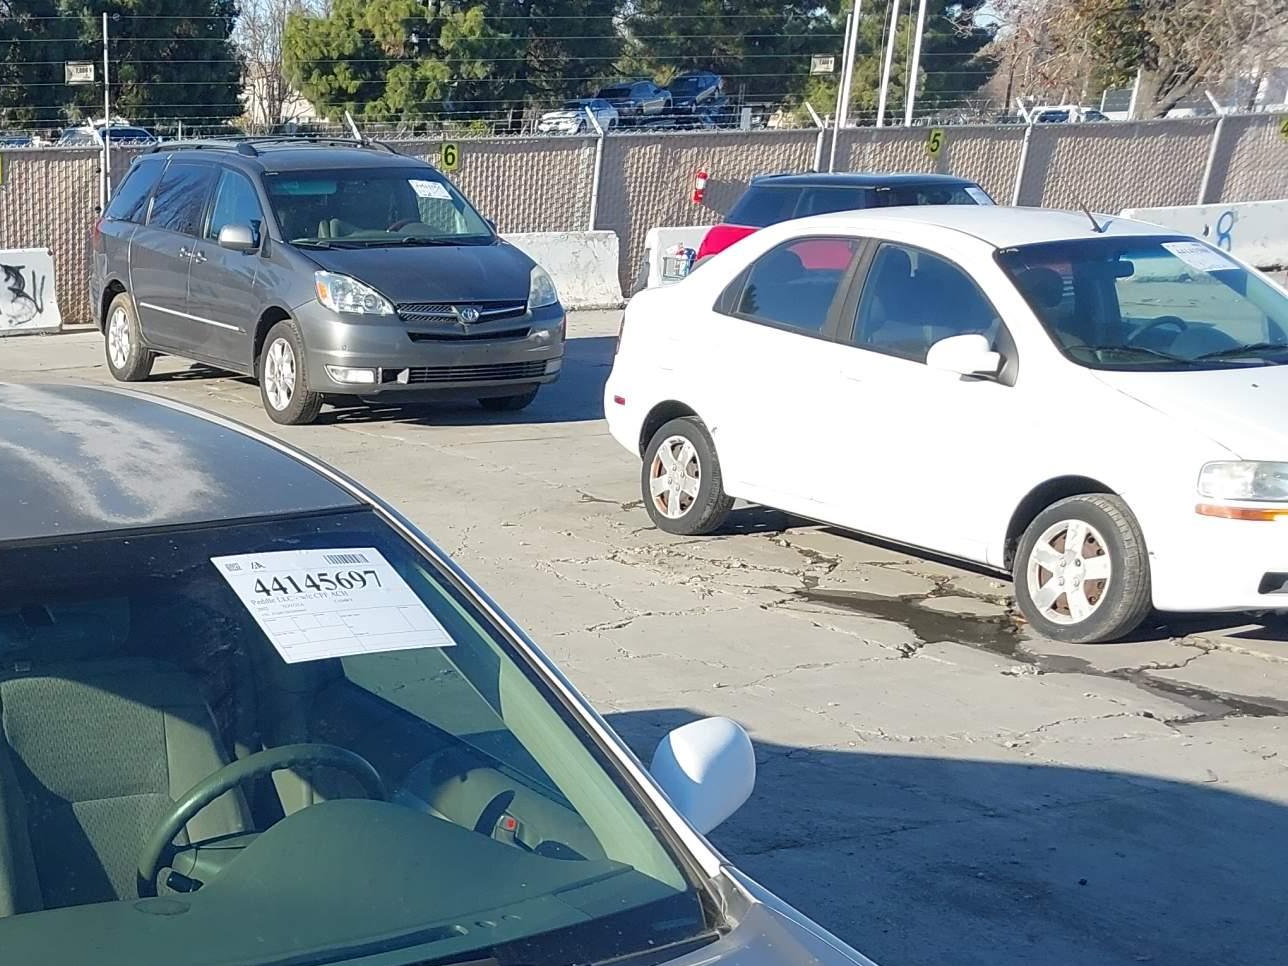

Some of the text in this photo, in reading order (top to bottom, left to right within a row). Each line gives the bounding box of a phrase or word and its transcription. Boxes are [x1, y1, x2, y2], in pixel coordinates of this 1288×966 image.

[930, 133, 941, 152] 5
[444, 144, 456, 166] 6
[253, 570, 382, 597] 44145697
